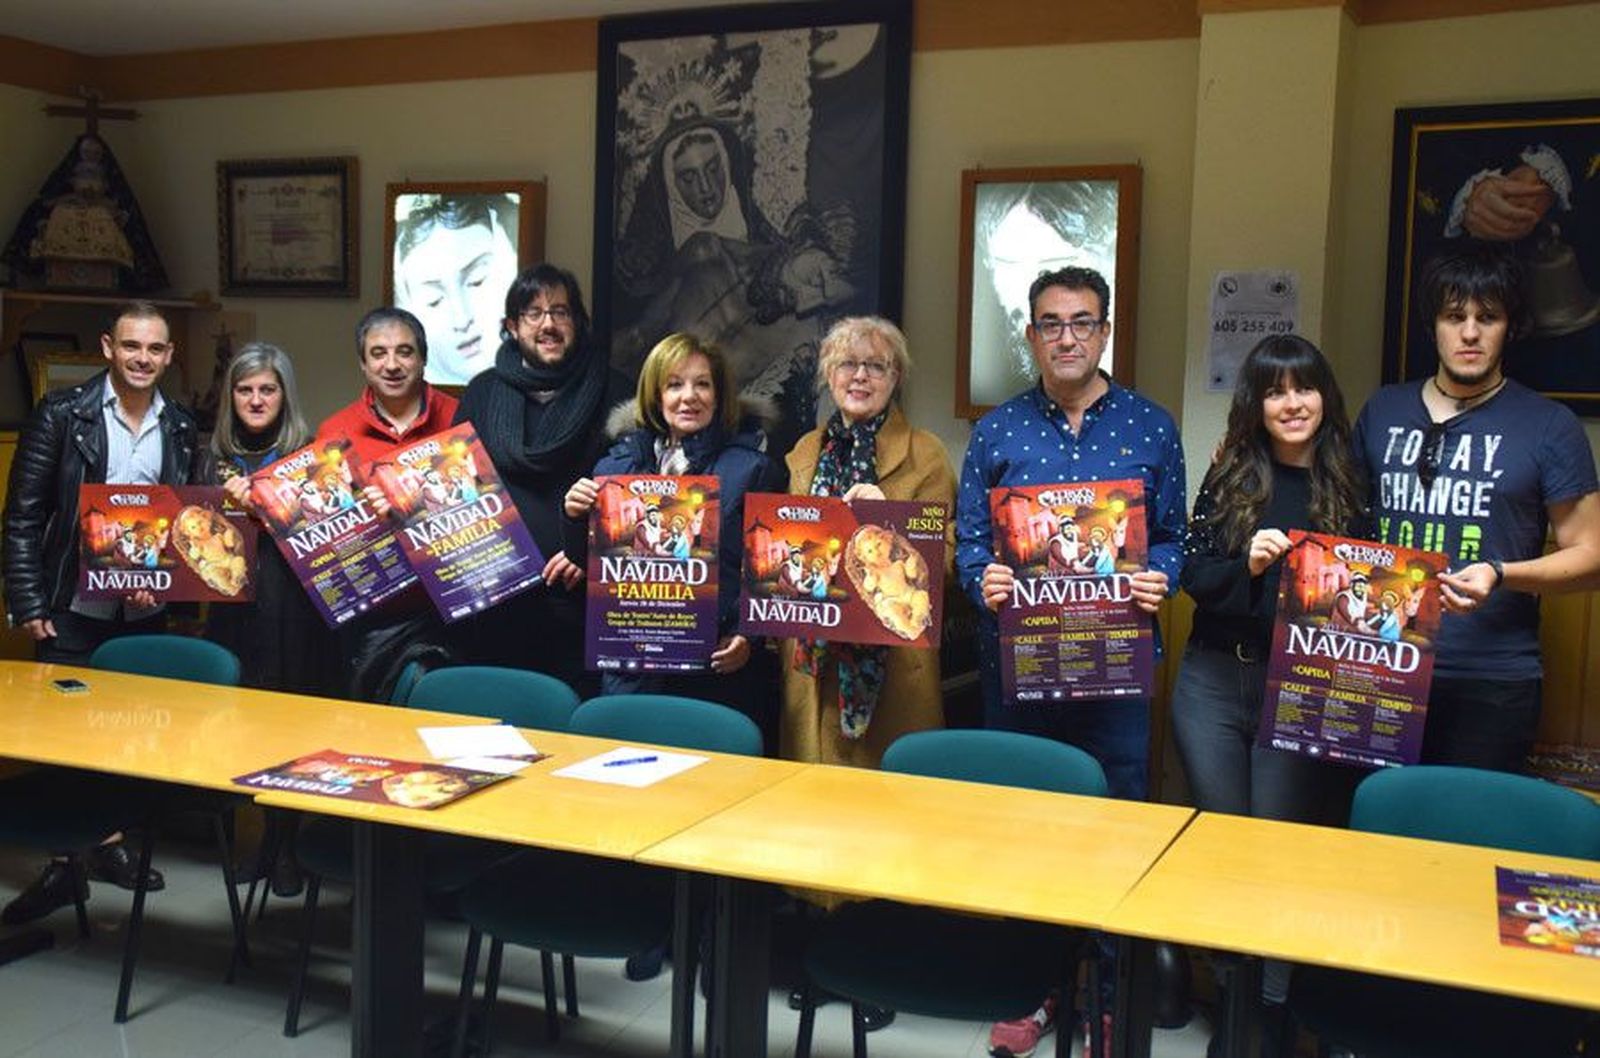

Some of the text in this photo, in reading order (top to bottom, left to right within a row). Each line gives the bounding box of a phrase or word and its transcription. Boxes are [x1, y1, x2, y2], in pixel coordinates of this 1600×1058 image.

[1383, 426, 1504, 478] TOAY,
[1380, 472, 1495, 518] CHANGE
[404, 492, 503, 550] NAVIDAD
[431, 518, 503, 556] FAMILIA
[1379, 516, 1482, 561] YOUR
[87, 569, 172, 590] NAVIDAD
[600, 556, 708, 585] NAVIDAD
[617, 583, 696, 600] FAMILIA
[1011, 573, 1135, 609] NAVIDAD
[748, 598, 841, 627] NAVIDAD
[1285, 623, 1420, 673] NAVIDAD
[1284, 682, 1311, 694] CALLE
